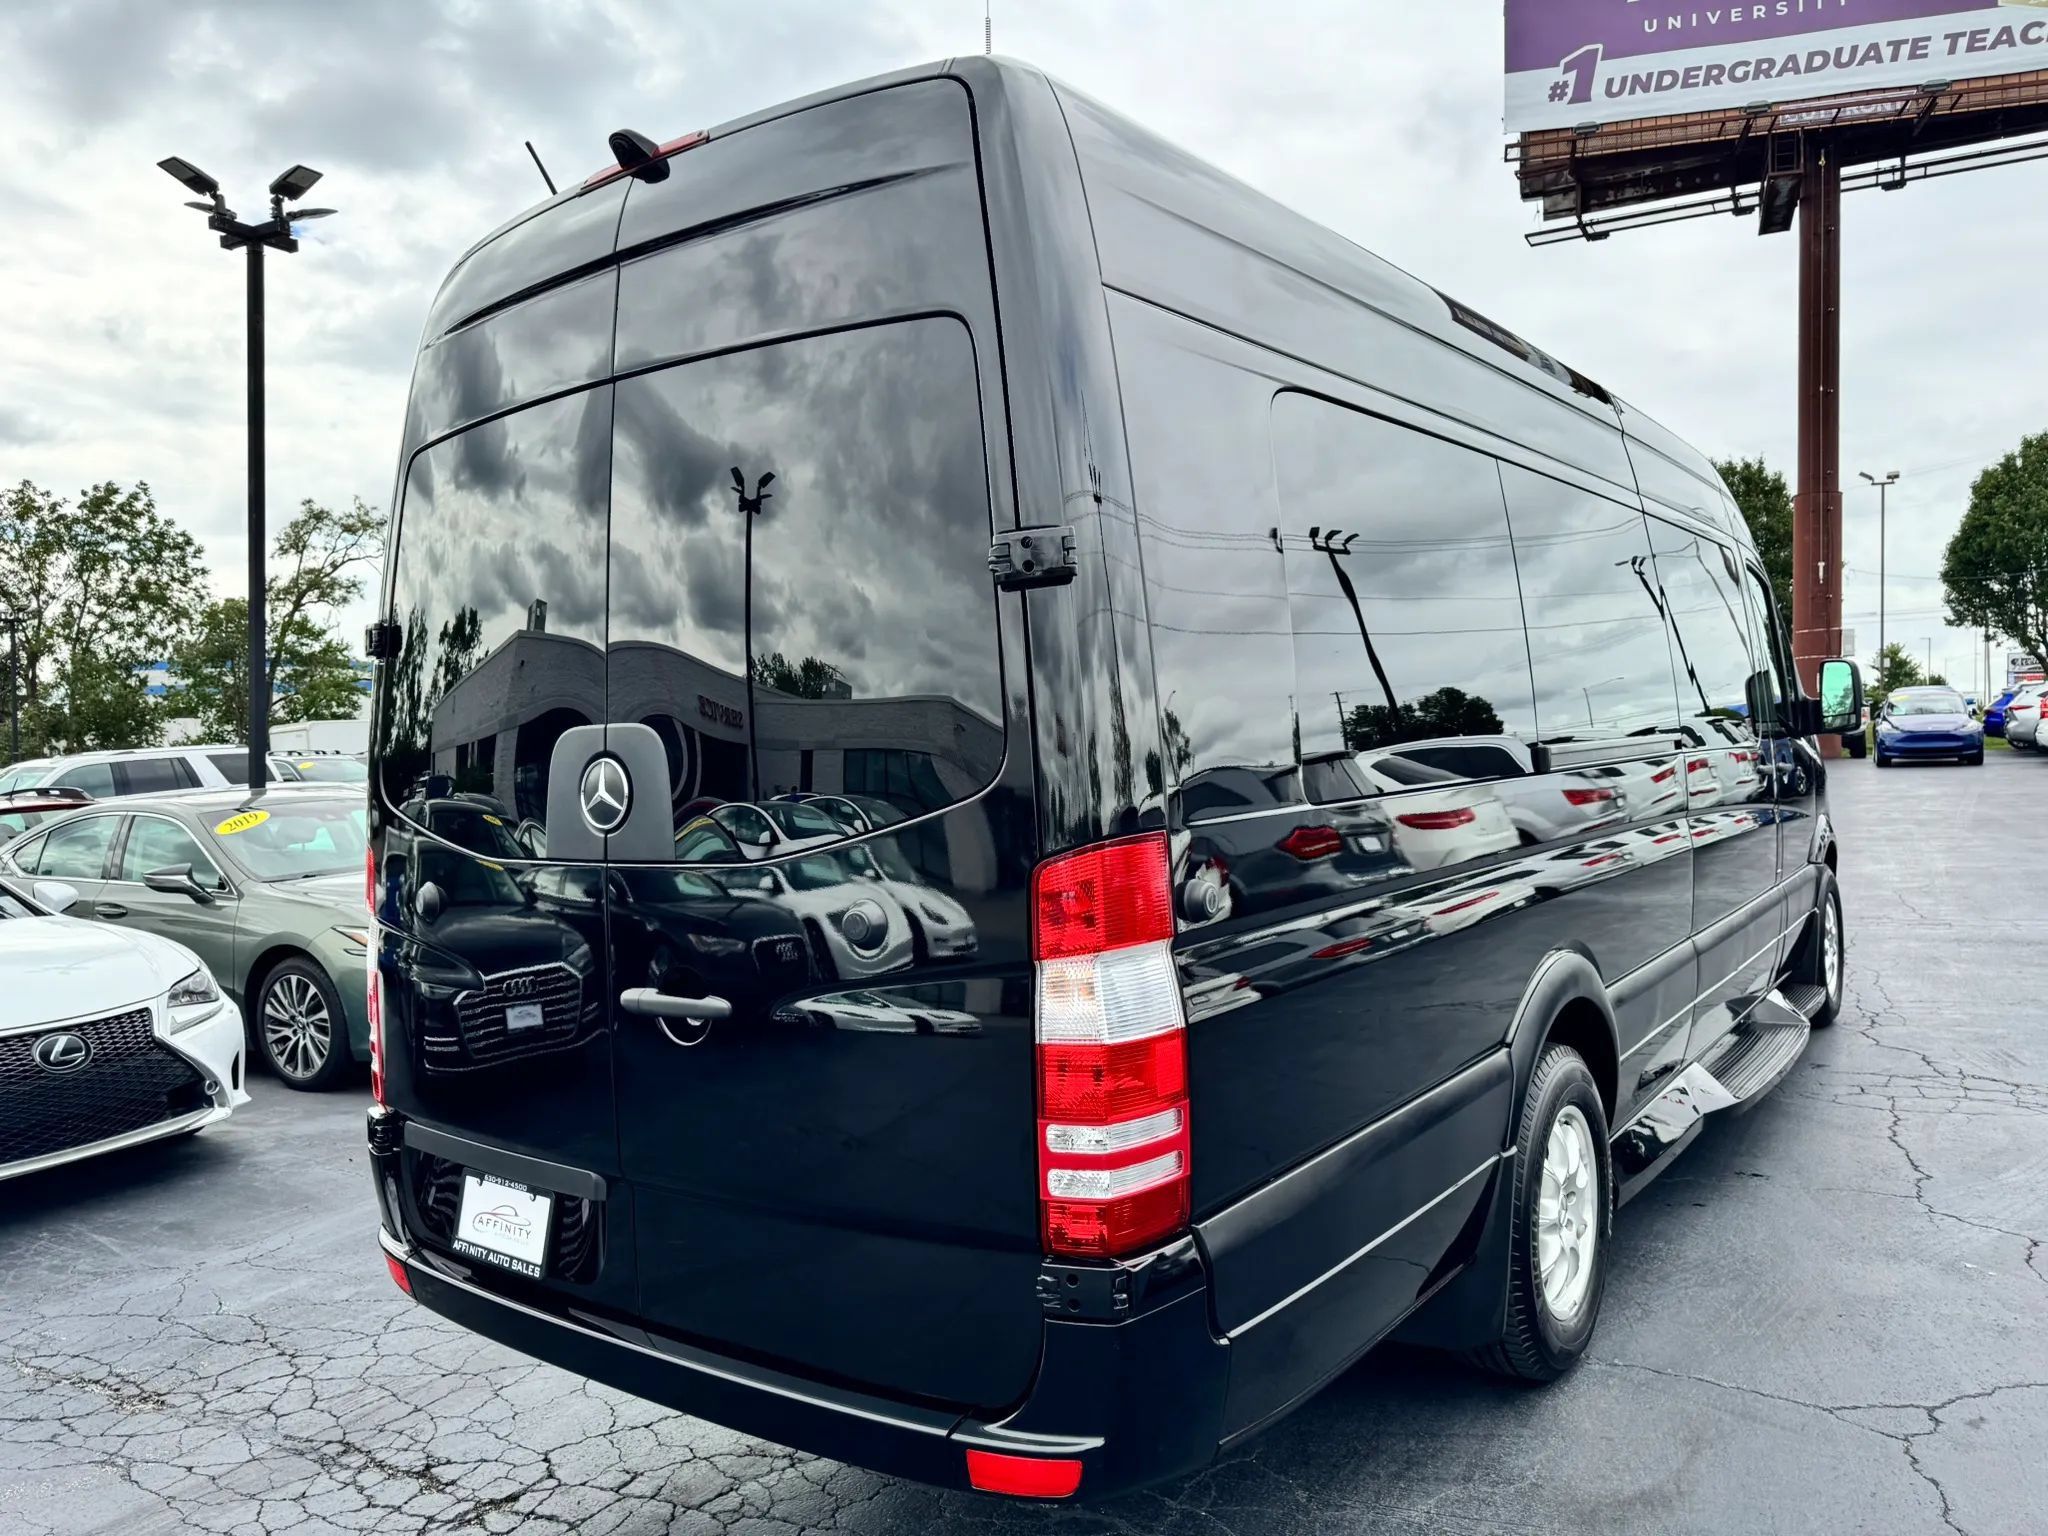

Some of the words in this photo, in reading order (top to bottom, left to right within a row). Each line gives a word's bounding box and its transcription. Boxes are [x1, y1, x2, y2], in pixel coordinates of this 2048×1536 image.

[1547, 45, 1601, 105] #1
[1604, 35, 1932, 99] UNDERGRADUATE
[1943, 20, 2048, 56] TEAC
[224, 812, 259, 832] 2019
[478, 1216, 532, 1240] AFFINITY
[452, 1239, 488, 1260] AFFINITY
[488, 1251, 511, 1268] AUTO
[511, 1259, 541, 1278] SALES
